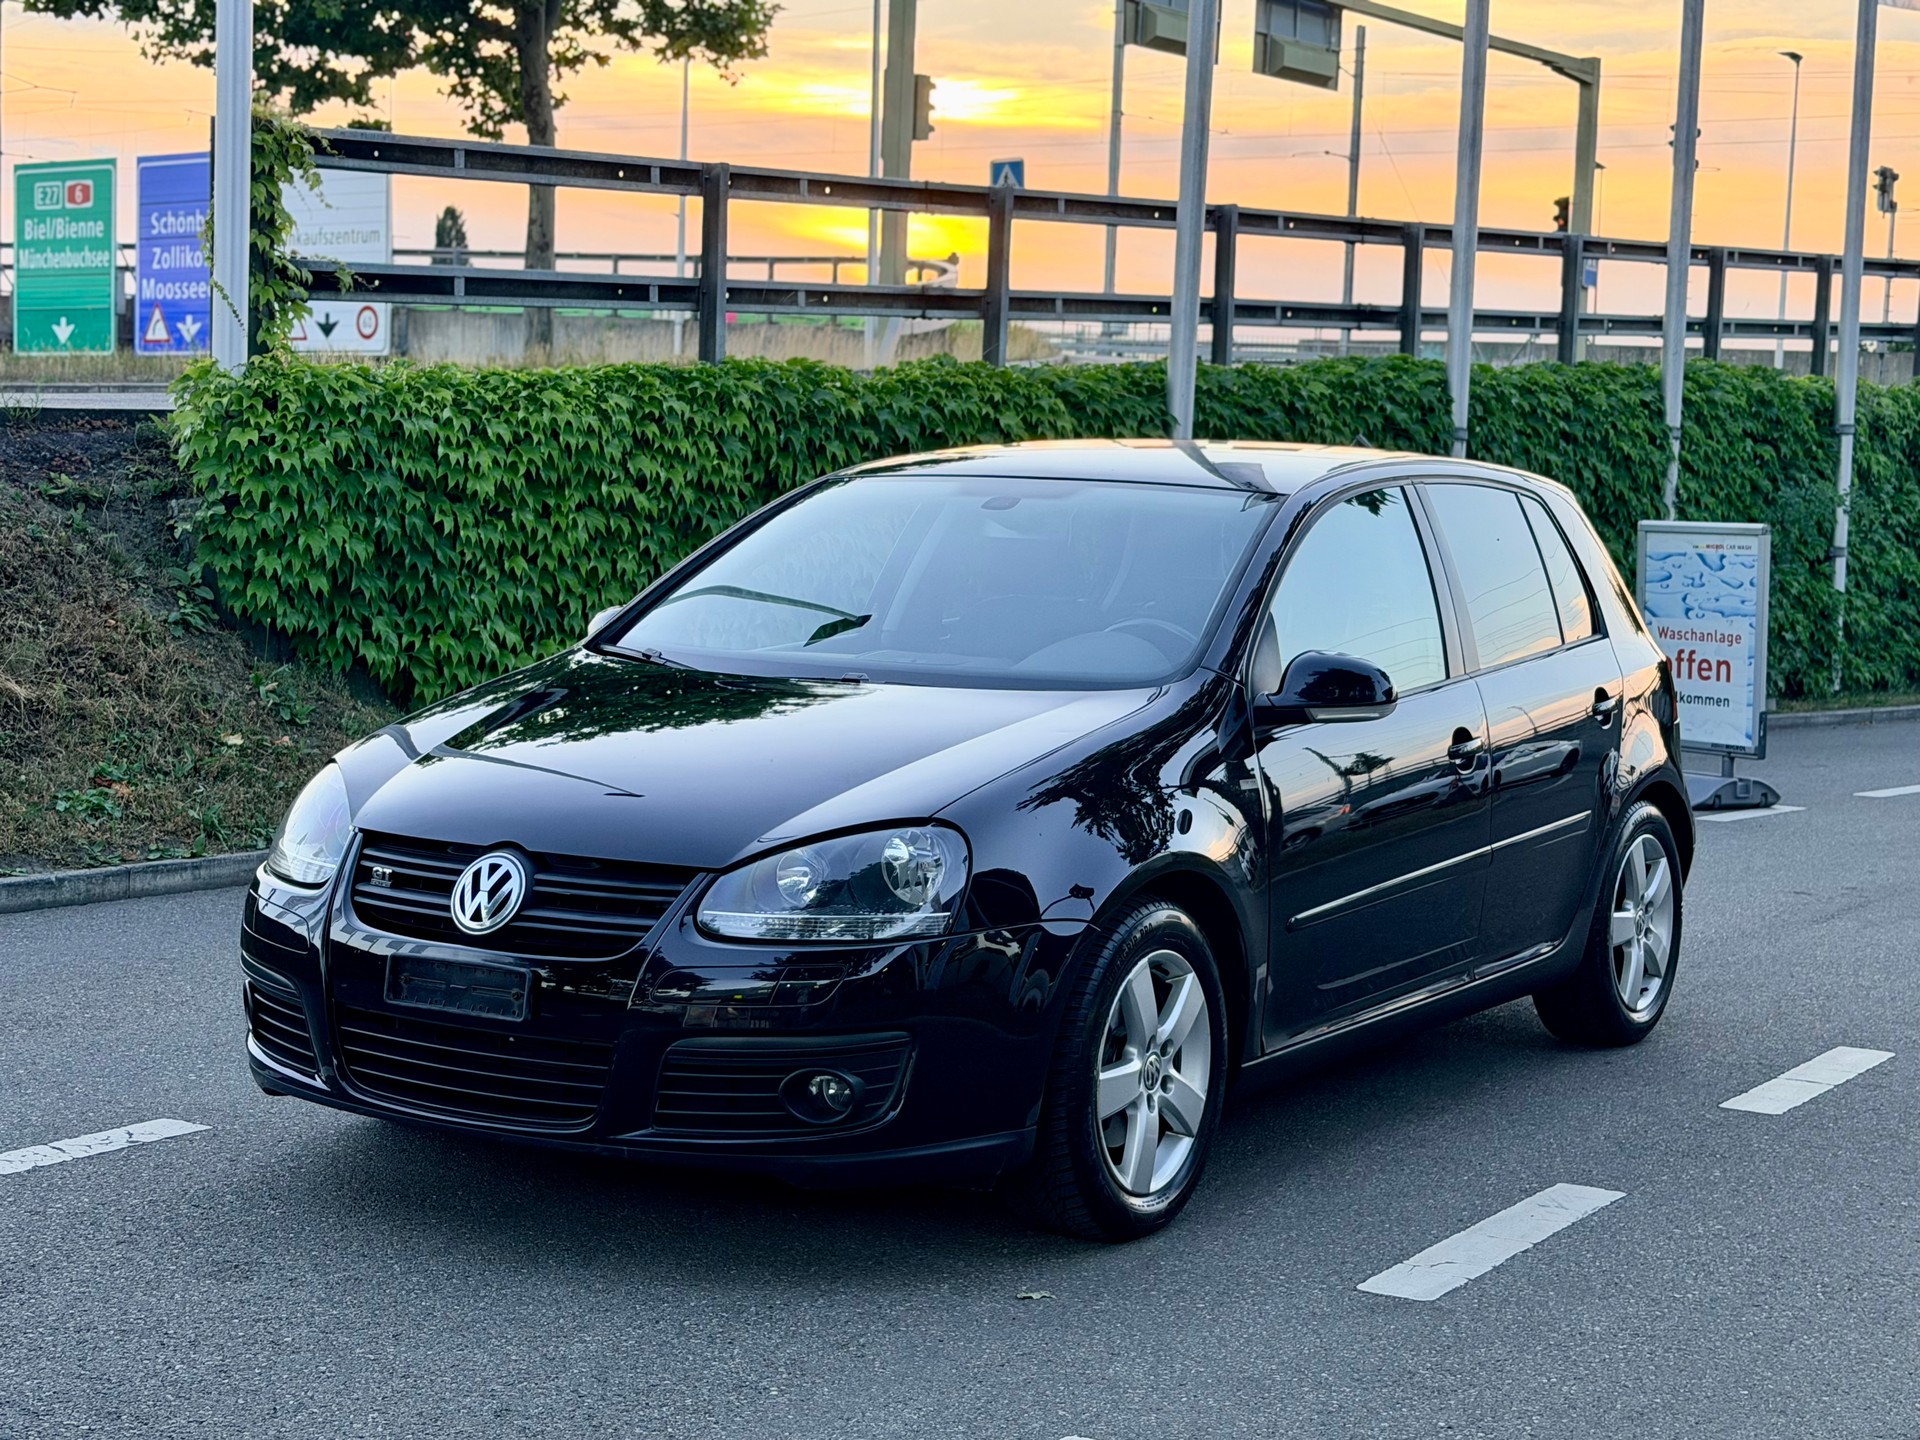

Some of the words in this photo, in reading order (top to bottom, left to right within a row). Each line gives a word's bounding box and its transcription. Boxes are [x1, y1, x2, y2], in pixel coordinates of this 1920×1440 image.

[38, 186, 58, 205] E27
[24, 217, 104, 240] Biel/Bienne
[151, 209, 207, 235] Schönb
[288, 227, 380, 246] nkaufszentrum
[19, 245, 110, 269] Münchenbuchsee
[152, 245, 206, 269] Zolliko
[1657, 626, 1742, 647] Waschanlage
[1675, 691, 1730, 708] lkommen
[372, 866, 393, 880] GT
